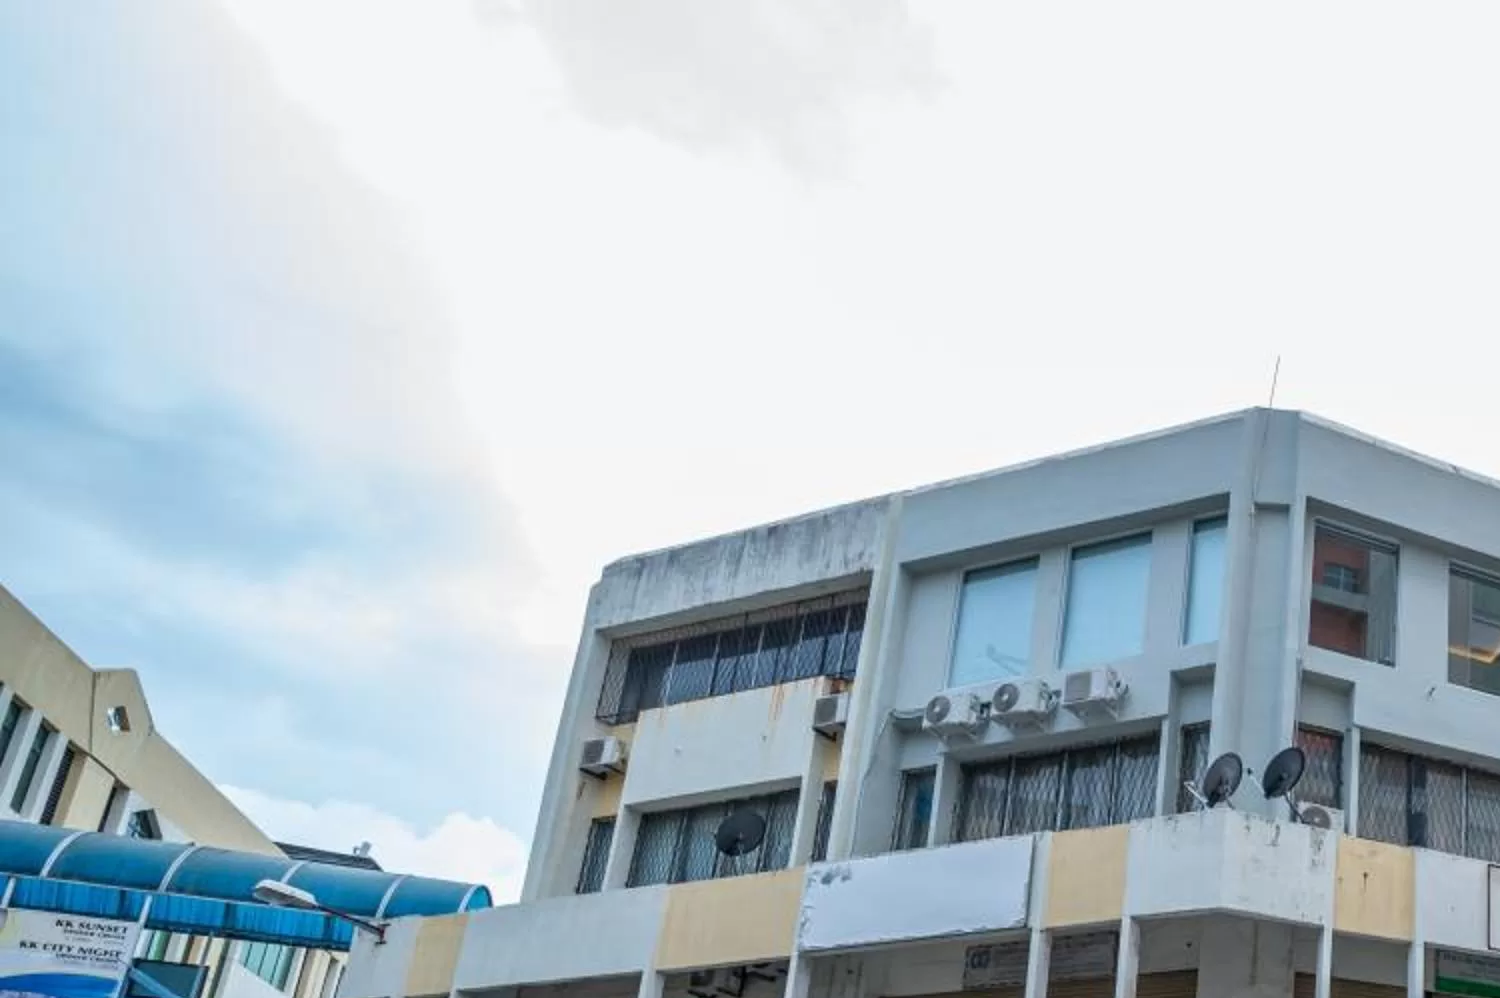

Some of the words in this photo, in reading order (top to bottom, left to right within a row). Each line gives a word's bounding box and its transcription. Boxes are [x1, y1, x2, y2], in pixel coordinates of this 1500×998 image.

[55, 919, 73, 929] KK
[79, 921, 127, 934] SUNSET
[20, 940, 37, 949] KK
[43, 943, 75, 953] CITY
[78, 946, 121, 958] NIGHT
